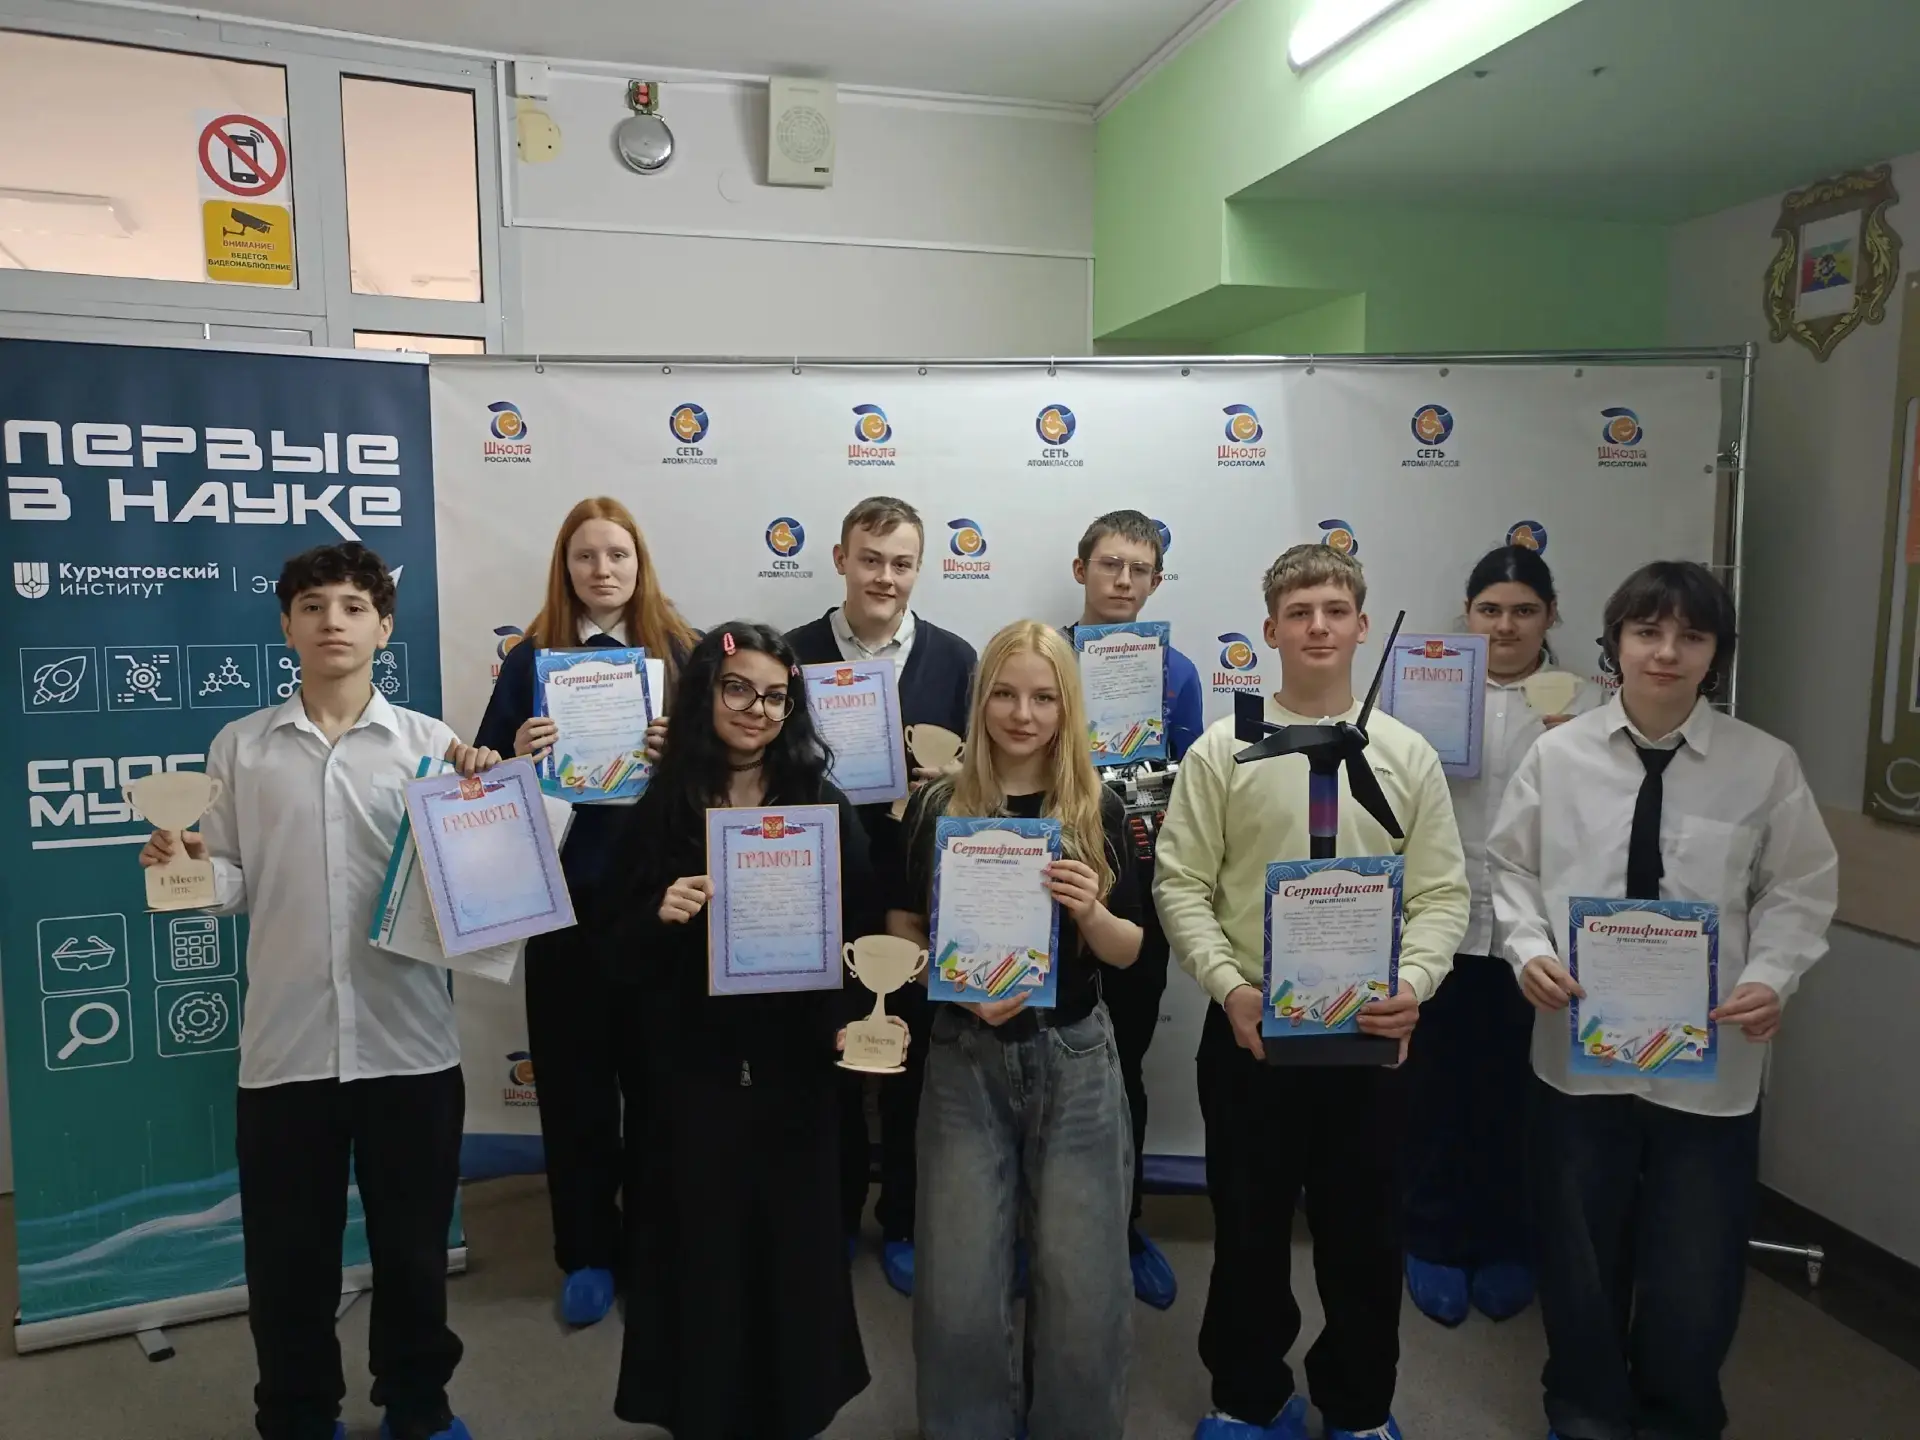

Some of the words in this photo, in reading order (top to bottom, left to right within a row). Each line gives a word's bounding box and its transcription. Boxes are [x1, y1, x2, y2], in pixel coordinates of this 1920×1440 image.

[208, 259, 291, 270] ВИДЕОНАБЛЮДЕНИЕ
[484, 441, 532, 456] Школа
[676, 447, 704, 457] СЕТЬ
[847, 444, 896, 459] Школа
[1042, 448, 1069, 459] СЕТЬ
[1217, 445, 1267, 459] Школа
[1416, 448, 1445, 459] СЕТЬ
[1597, 446, 1647, 460] Школа
[484, 456, 532, 464] РОСАТОМА
[662, 457, 718, 466] АТОМКЛАССОВ
[848, 459, 896, 467] РОСАТОМА
[1027, 459, 1084, 467] АТОМКЛАССОВ
[1401, 460, 1461, 468] АТОМКЛАССОВ
[59, 562, 220, 582] Курчатовский
[772, 560, 799, 570] СЕТЬ
[943, 558, 991, 572] Школа
[60, 582, 164, 598] институт
[1087, 642, 1157, 656] Сертификат
[554, 671, 634, 688] Сертификат
[1212, 672, 1262, 686] Школа
[952, 841, 1044, 861] Сертификат
[736, 849, 813, 870] ГРАМОТА
[1284, 882, 1384, 900] Сертификат
[1589, 921, 1698, 939] Сертификат
